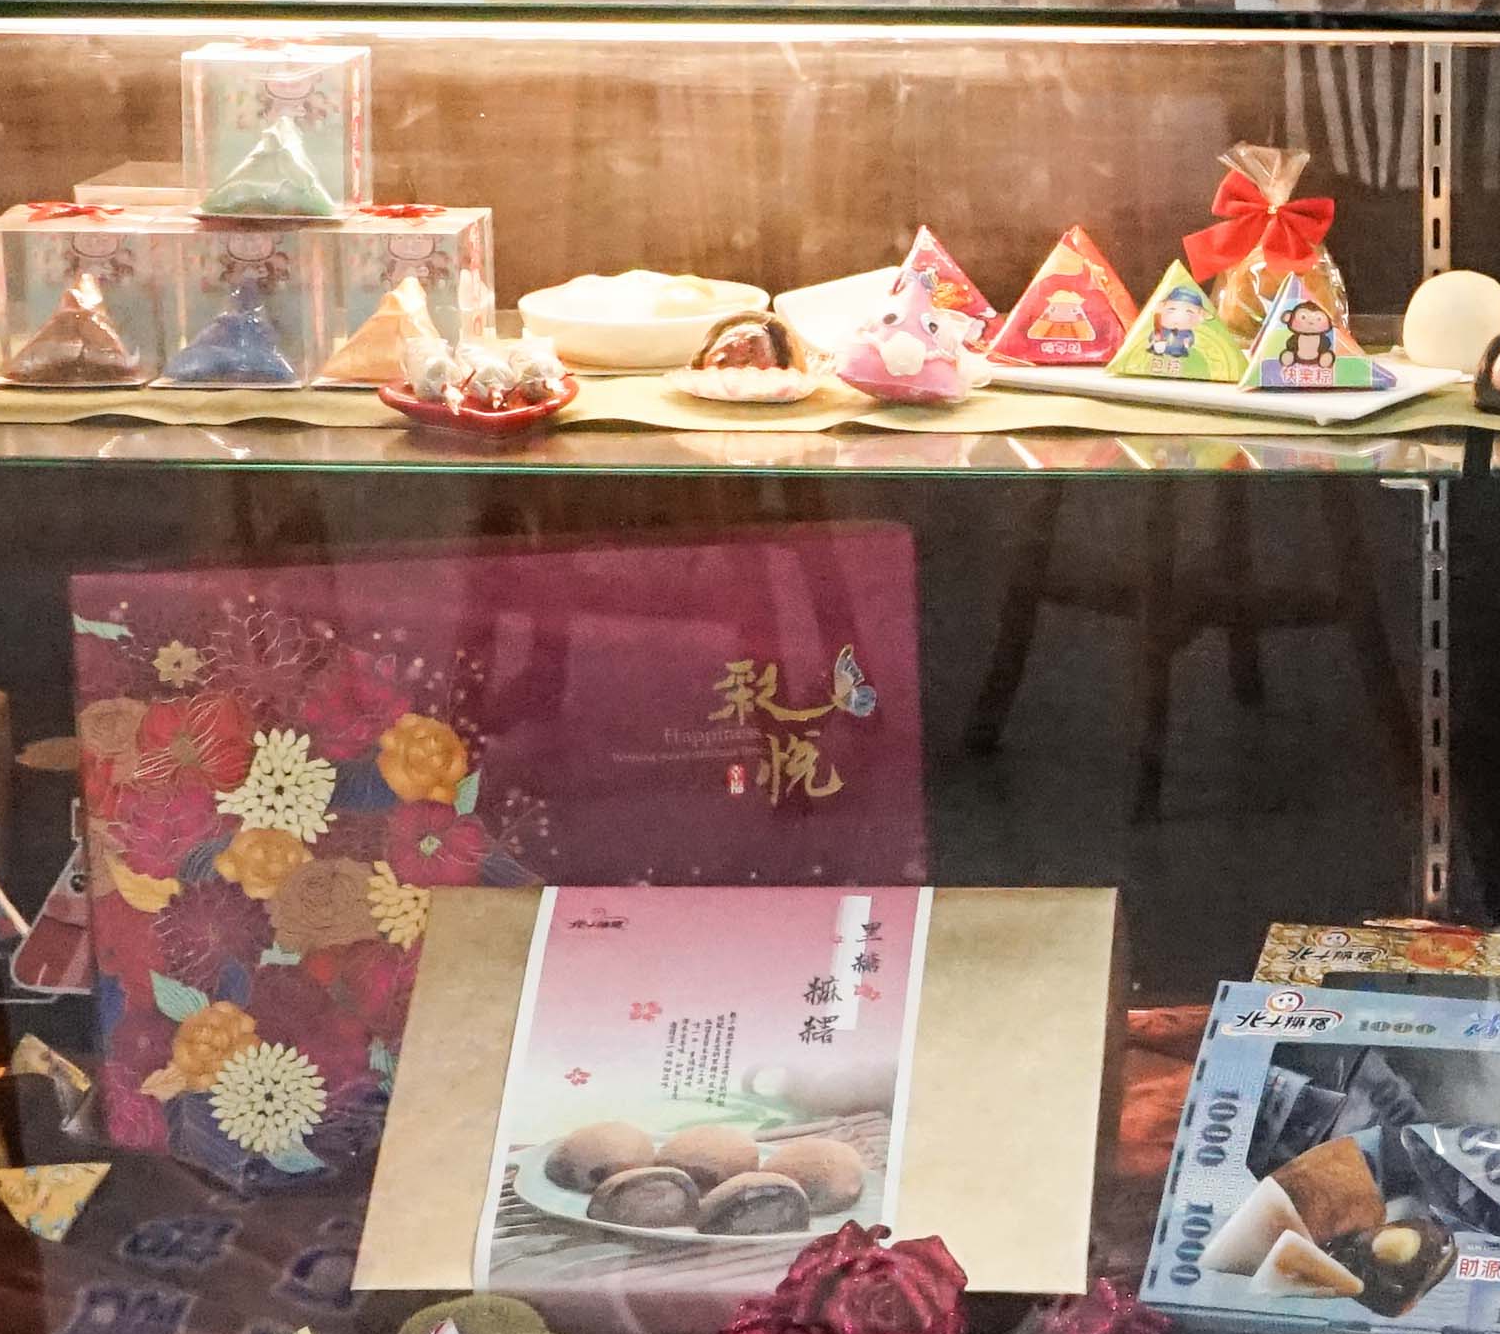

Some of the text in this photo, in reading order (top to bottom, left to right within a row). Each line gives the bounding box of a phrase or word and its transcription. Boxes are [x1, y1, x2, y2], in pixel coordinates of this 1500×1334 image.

[1359, 1020, 1437, 1035] 1000
[1197, 1088, 1240, 1167] 1000
[1169, 1202, 1215, 1286] 1000
